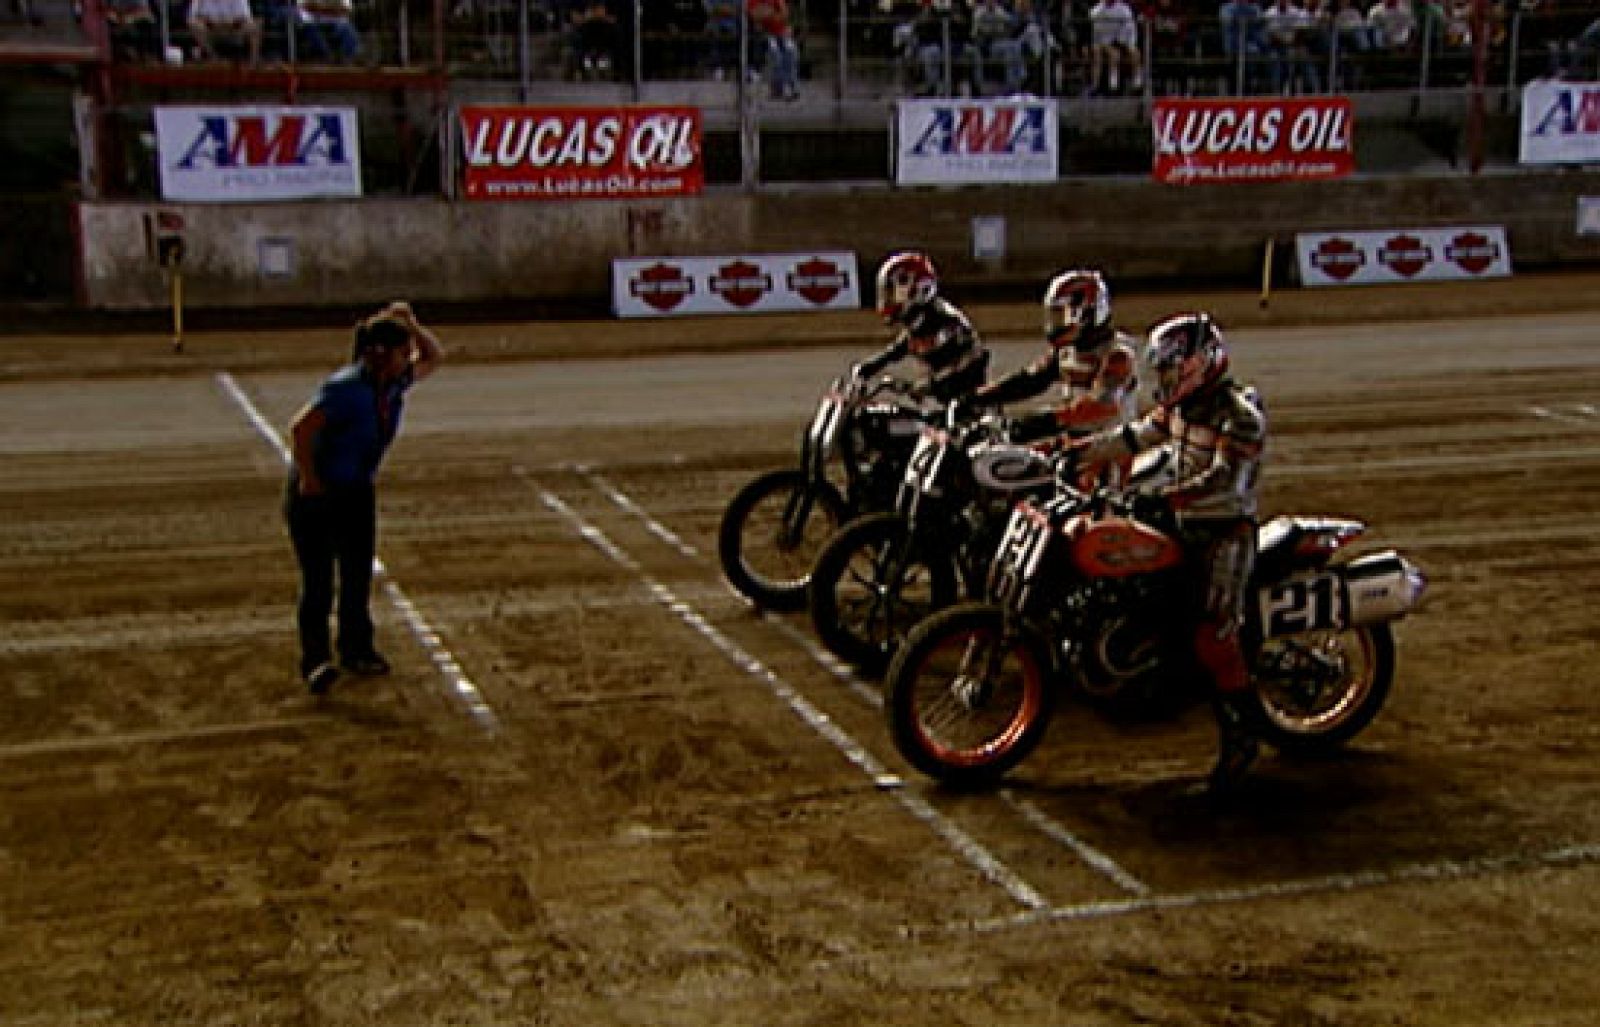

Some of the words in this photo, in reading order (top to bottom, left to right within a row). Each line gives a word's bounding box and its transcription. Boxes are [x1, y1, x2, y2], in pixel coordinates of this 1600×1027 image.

[177, 115, 347, 169] AMA
[469, 117, 621, 167] LUCAS
[912, 107, 1049, 154] AMA
[1160, 108, 1283, 154] LUCAS
[1291, 107, 1346, 151] OIL
[1270, 575, 1332, 634] 21
